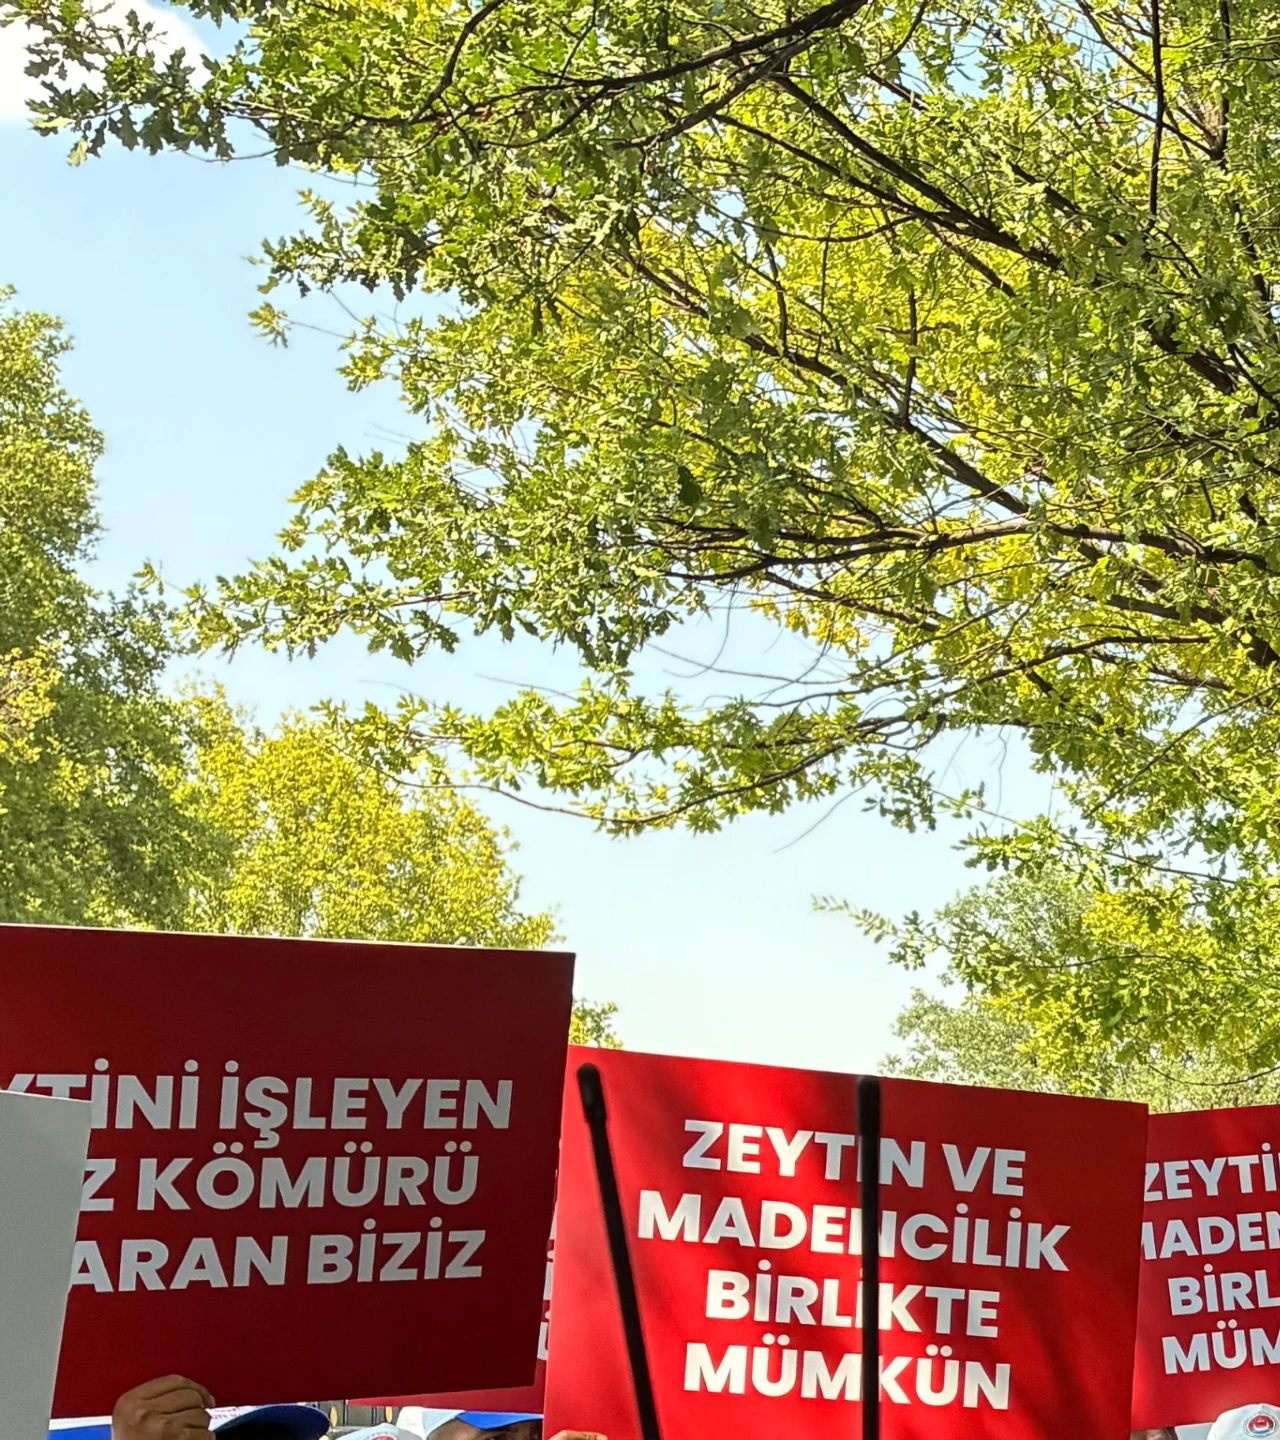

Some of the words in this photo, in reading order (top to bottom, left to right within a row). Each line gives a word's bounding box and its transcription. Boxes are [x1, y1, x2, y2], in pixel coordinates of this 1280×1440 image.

[0, 1057, 200, 1130] TİNİ
[218, 1060, 514, 1150] İŞLEYEN
[137, 1141, 480, 1212] KÖMÜRÜ
[683, 1119, 926, 1189] ZEYTN
[942, 1143, 1026, 1197] VE
[306, 1217, 486, 1286] BİZİZ
[638, 1190, 1071, 1272] MADENCİLİK
[683, 1334, 1011, 1411] MÜMKÜN
